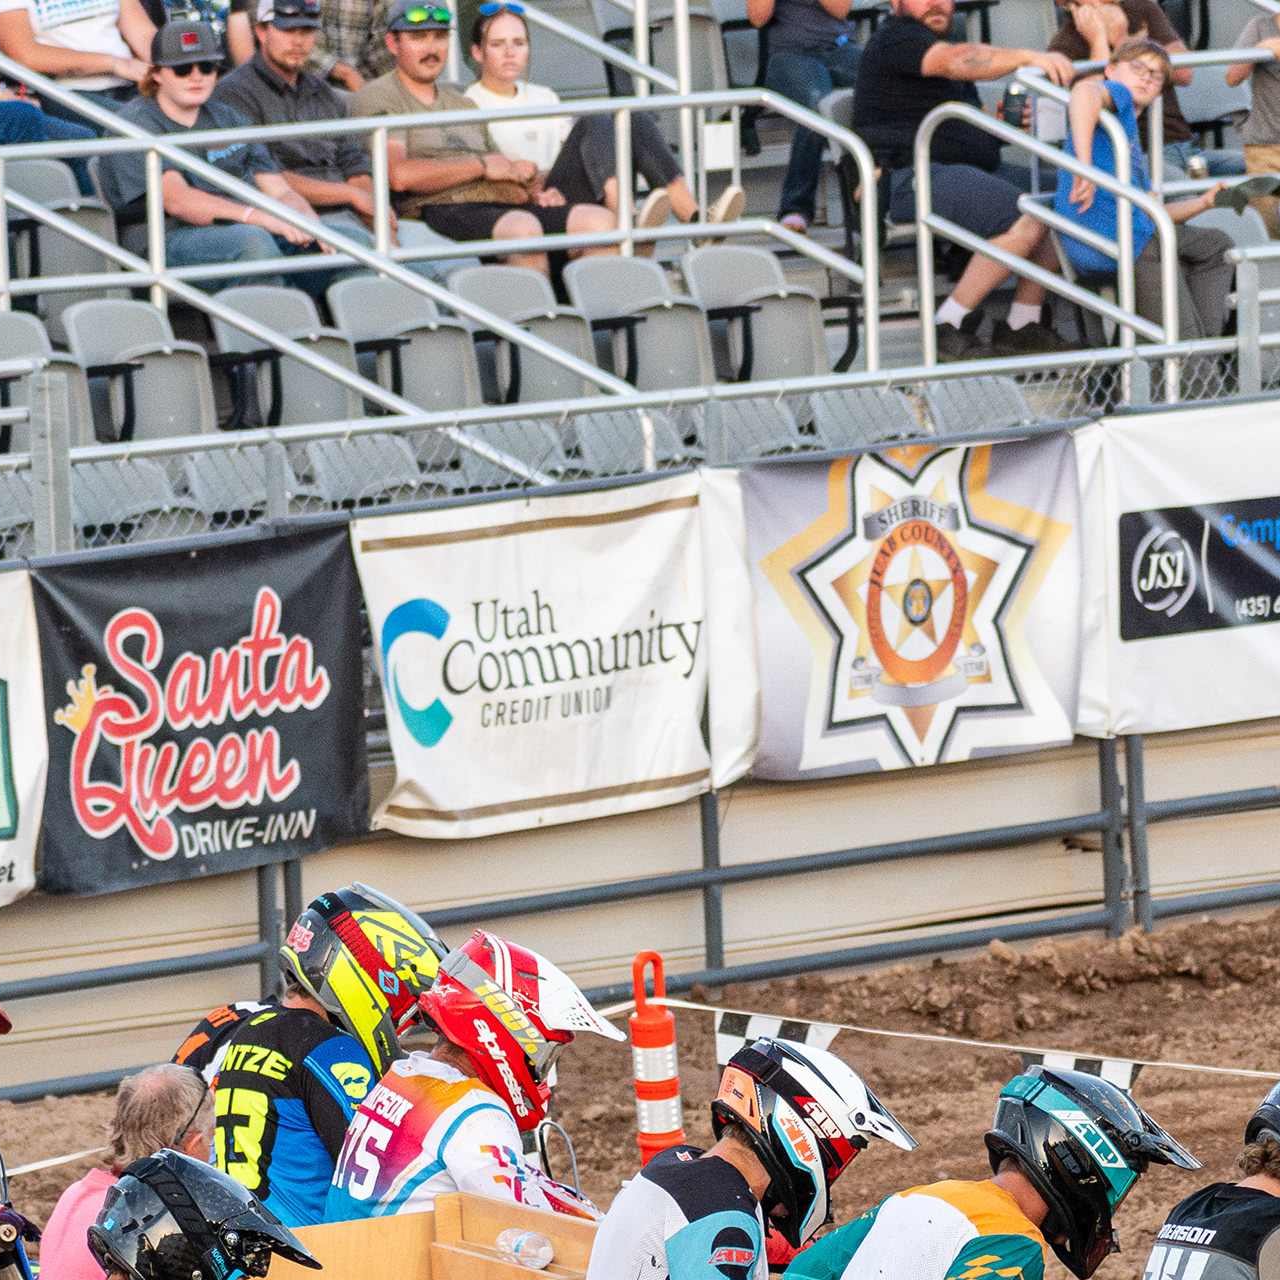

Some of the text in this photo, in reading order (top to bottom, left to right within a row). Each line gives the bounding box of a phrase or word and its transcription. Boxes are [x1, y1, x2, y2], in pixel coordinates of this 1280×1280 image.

[877, 499, 948, 531] SHERIFF
[870, 523, 961, 589] JUAB COUNTY
[1140, 553, 1183, 592] JSI
[472, 589, 557, 643] Utah
[1235, 595, 1270, 620] (435)
[104, 586, 330, 743] Santa
[442, 609, 703, 695] Community
[481, 686, 612, 728] CREDIT UNION
[73, 692, 302, 860] Queen
[181, 809, 317, 858] DRIVE-INN
[474, 979, 538, 1055] 100%
[473, 1018, 529, 1118] alpinestars
